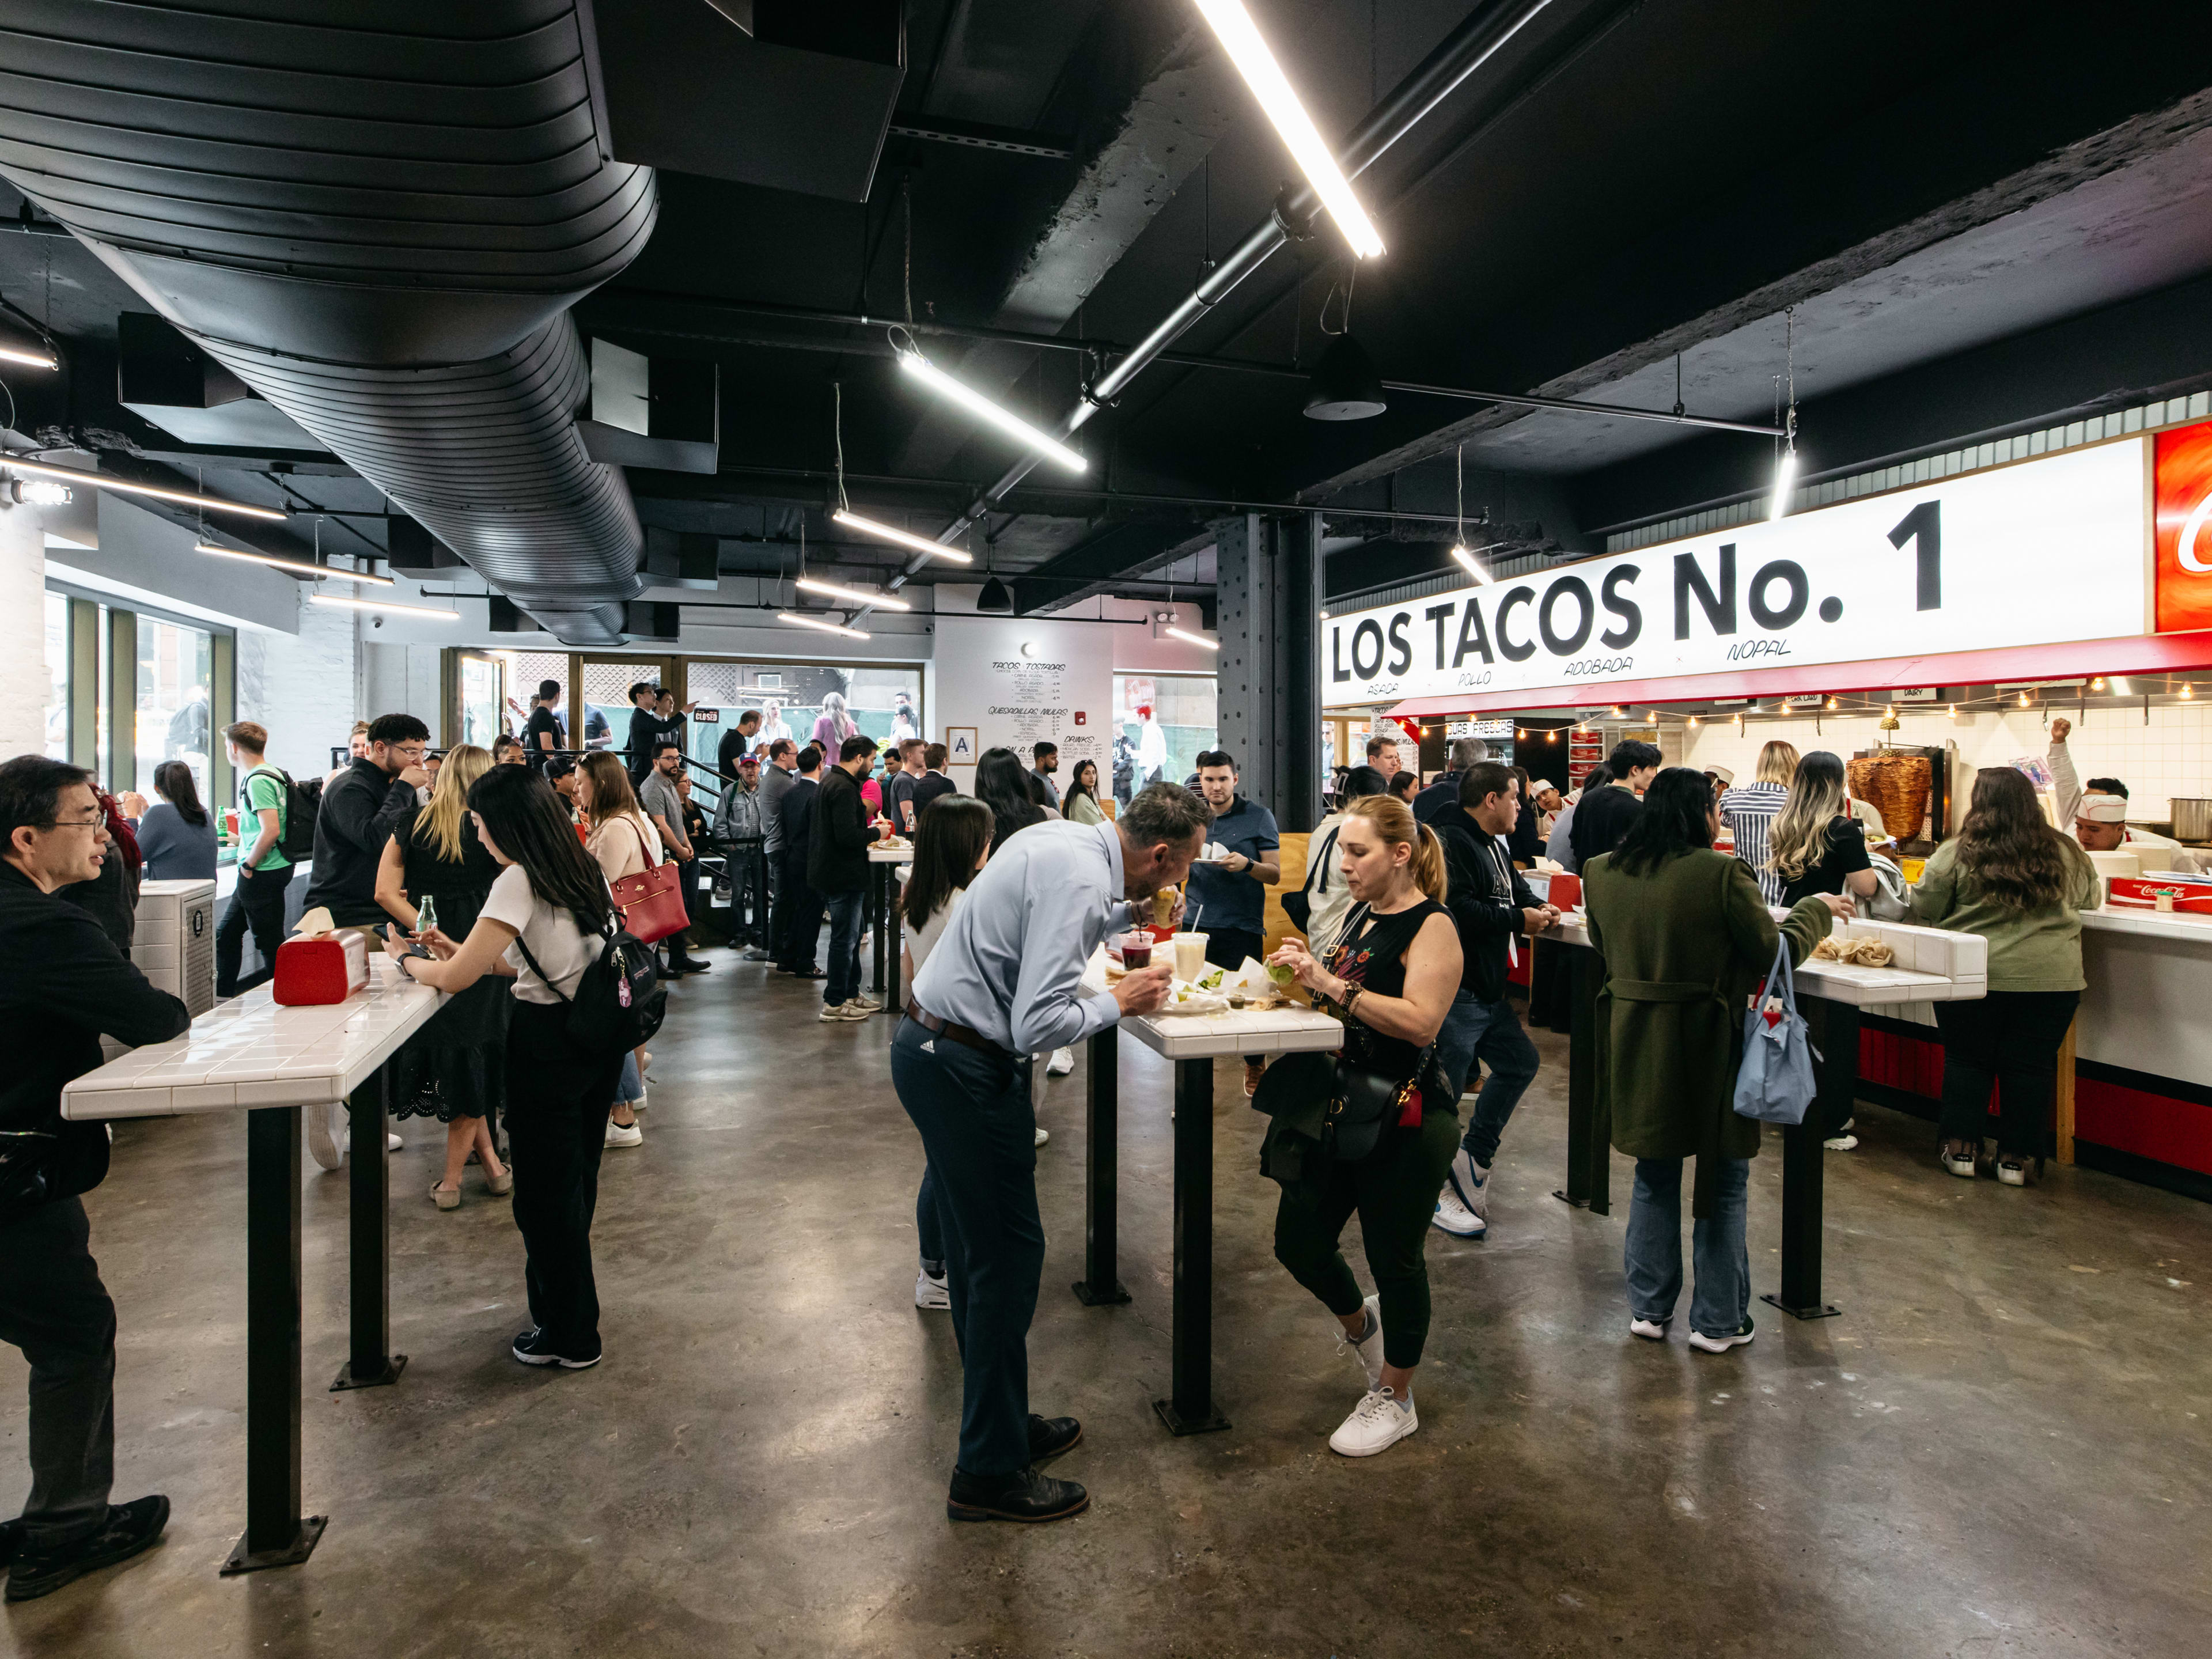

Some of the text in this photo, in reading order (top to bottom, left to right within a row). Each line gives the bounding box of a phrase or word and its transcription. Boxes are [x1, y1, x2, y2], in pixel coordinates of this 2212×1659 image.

[1333, 499, 1941, 683] LOS TACOS No. 1
[1727, 639, 1791, 661] NOPAL
[1026, 663, 1066, 672] TOSTADAS
[1563, 656, 1634, 676] ADOBADA
[1458, 671, 1491, 687] POLLO
[1368, 683, 1399, 695] ASADA
[1904, 688, 1923, 696] DAIRY
[695, 713, 718, 721] CLOSED
[988, 706, 1068, 716] QUESADILLAS MULAS
[1474, 721, 1513, 734] FRESCAS
[955, 737, 968, 752] A
[1064, 736, 1095, 744] DRINKS
